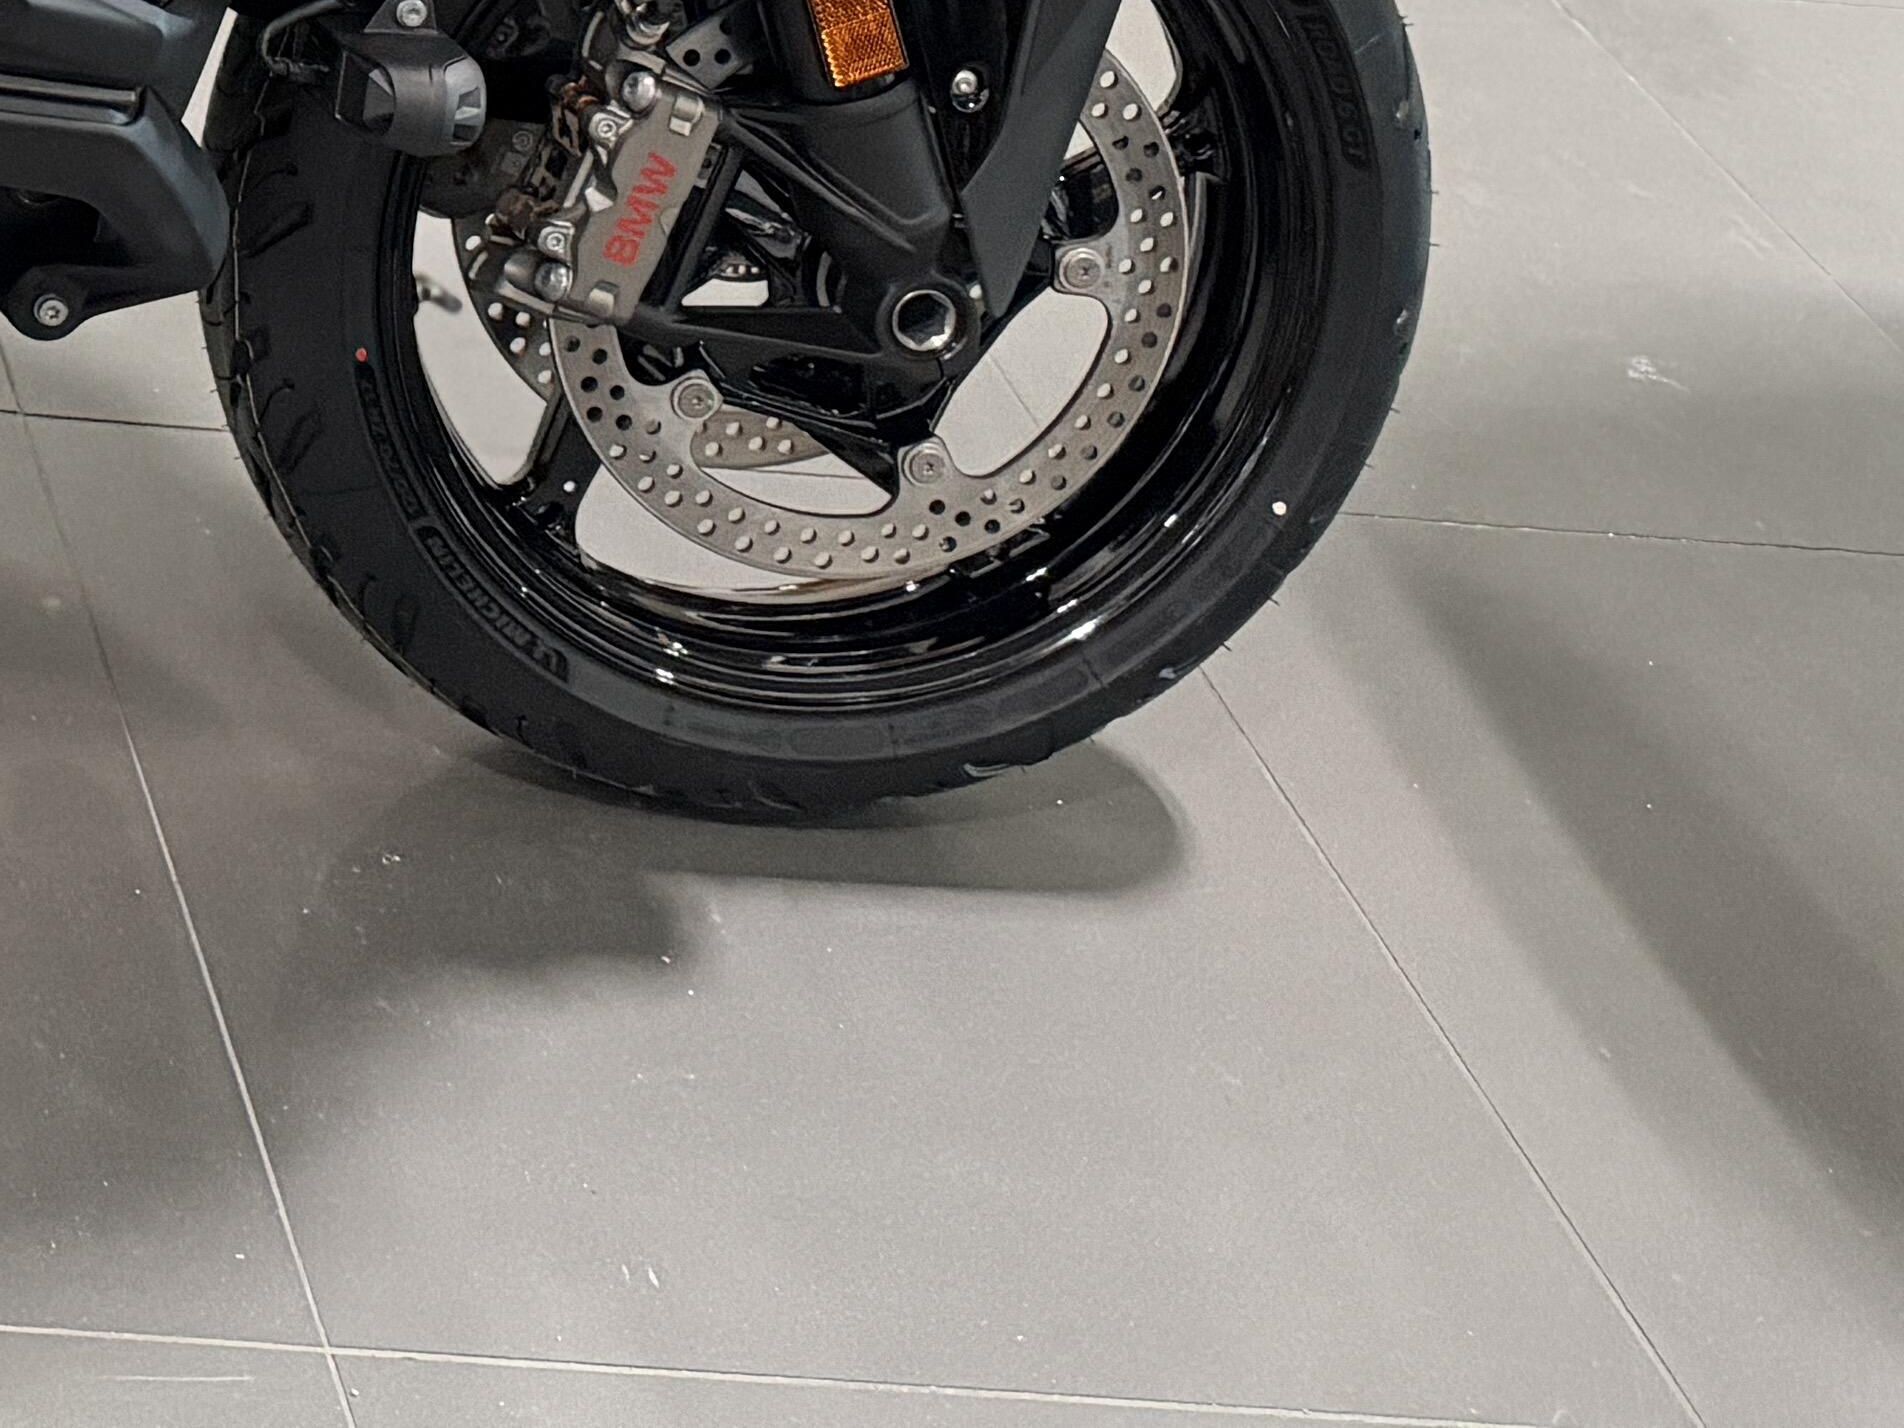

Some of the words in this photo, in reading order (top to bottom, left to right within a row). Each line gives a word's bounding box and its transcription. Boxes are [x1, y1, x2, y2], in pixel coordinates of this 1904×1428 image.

[1304, 21, 1352, 93] ROAD
[603, 152, 678, 267] BMW
[426, 537, 533, 646] MICHELIN
